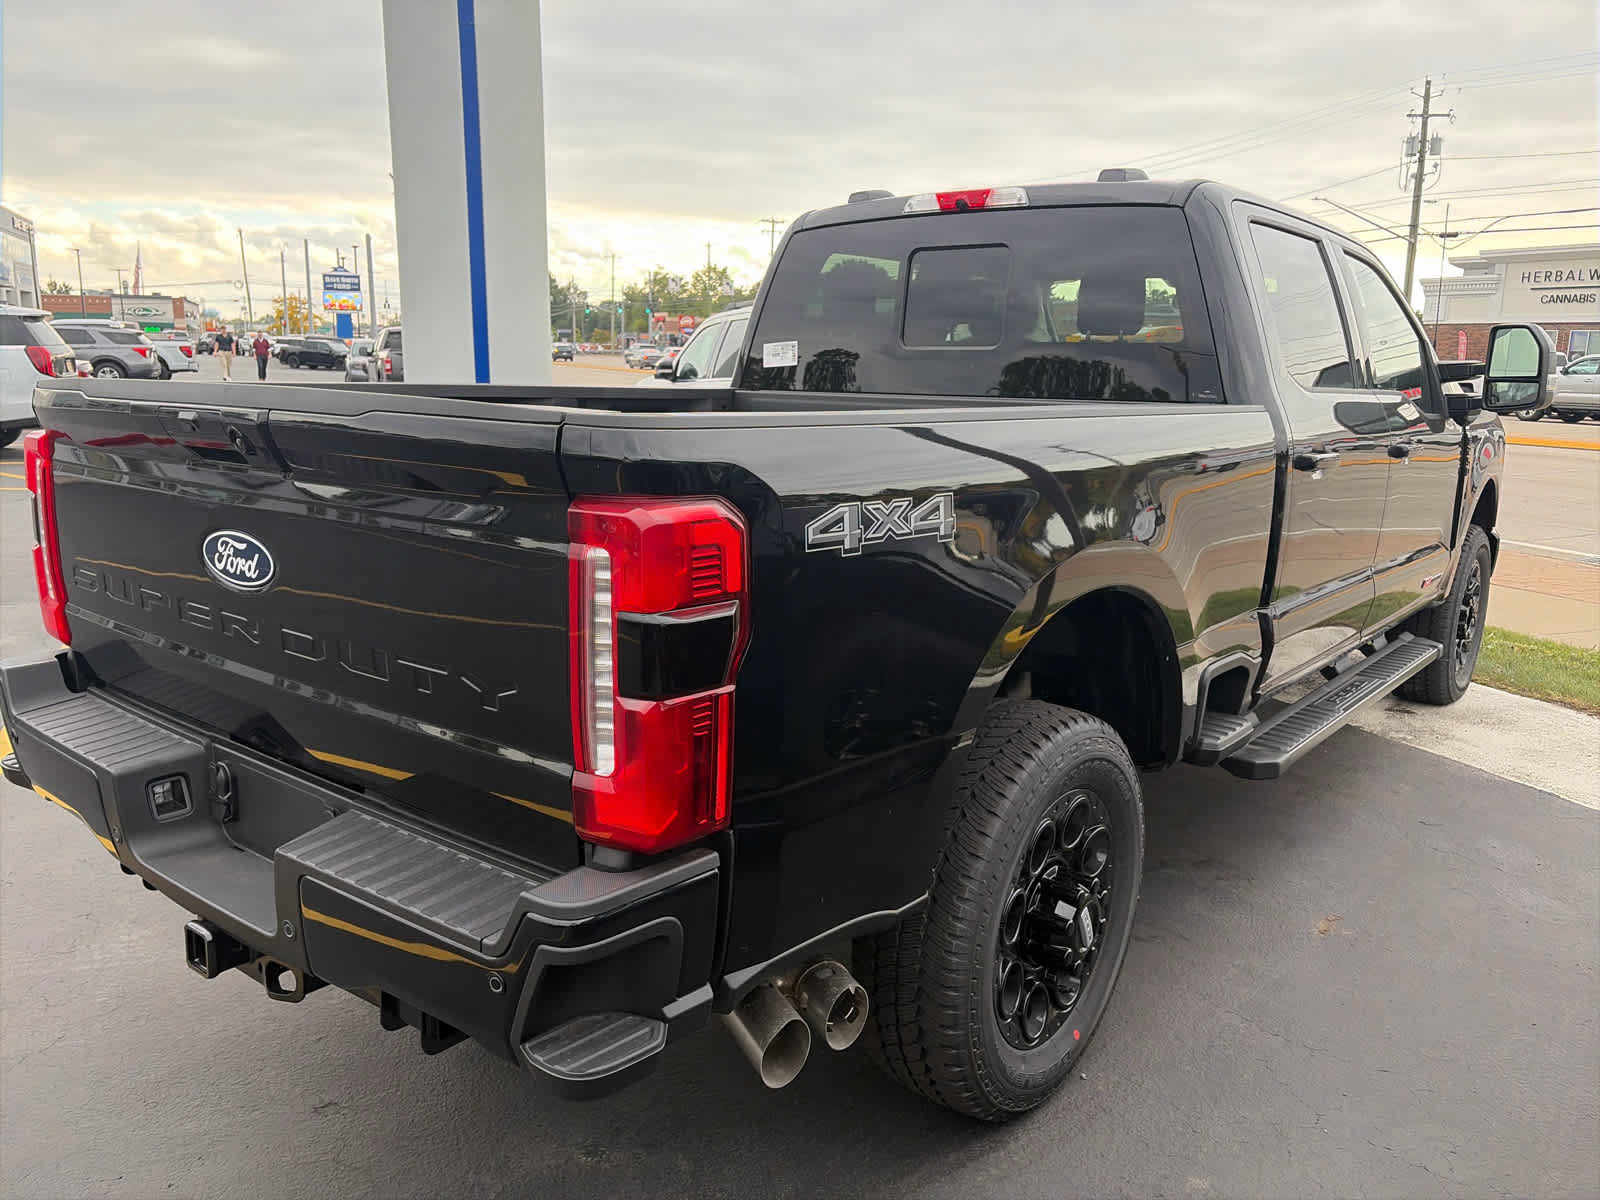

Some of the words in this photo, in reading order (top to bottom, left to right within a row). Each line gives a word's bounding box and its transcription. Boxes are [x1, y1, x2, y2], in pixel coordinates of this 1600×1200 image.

[1521, 269, 1585, 283] HERBAL
[1540, 293, 1597, 305] CANNABIS
[213, 536, 260, 579] Ford
[72, 564, 265, 645] SUPER
[280, 625, 519, 712] DUTY
